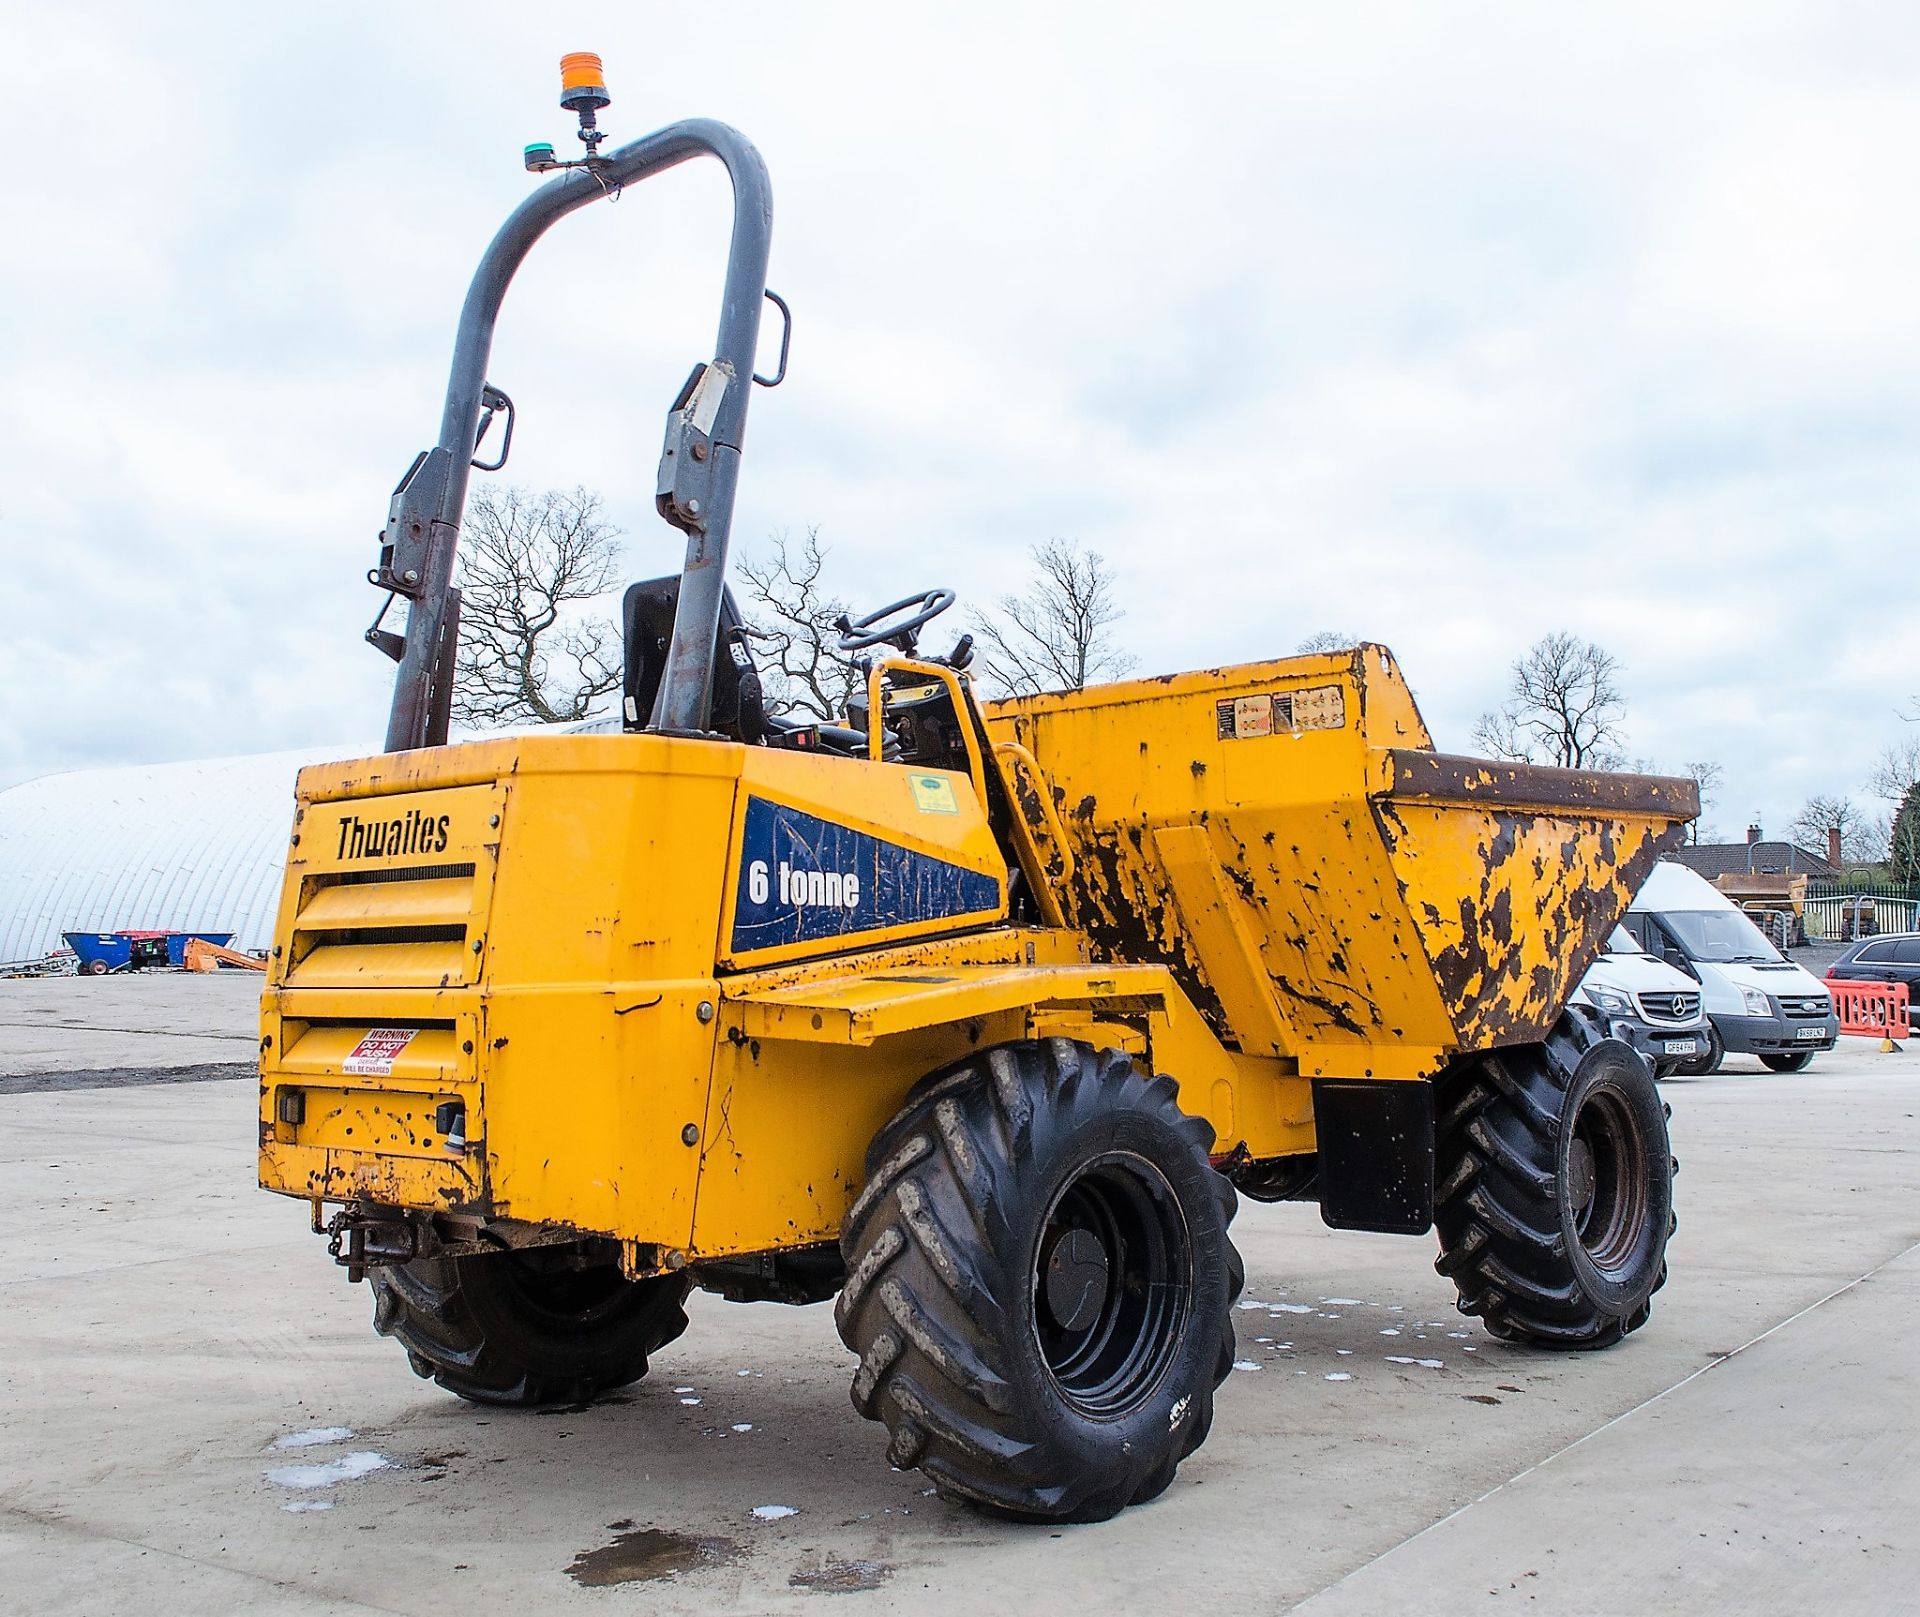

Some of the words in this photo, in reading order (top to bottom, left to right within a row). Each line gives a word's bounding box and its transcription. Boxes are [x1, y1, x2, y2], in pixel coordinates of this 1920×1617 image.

[337, 809, 450, 860] Thwaites
[749, 860, 769, 905] 6
[778, 861, 860, 908] tonne
[369, 1030, 414, 1040] WARNING
[360, 1041, 379, 1049] DO
[380, 1041, 406, 1050] NOT
[359, 1049, 392, 1057] PUSH
[344, 1065, 357, 1073] WILL
[366, 1066, 390, 1074] CHARGED
